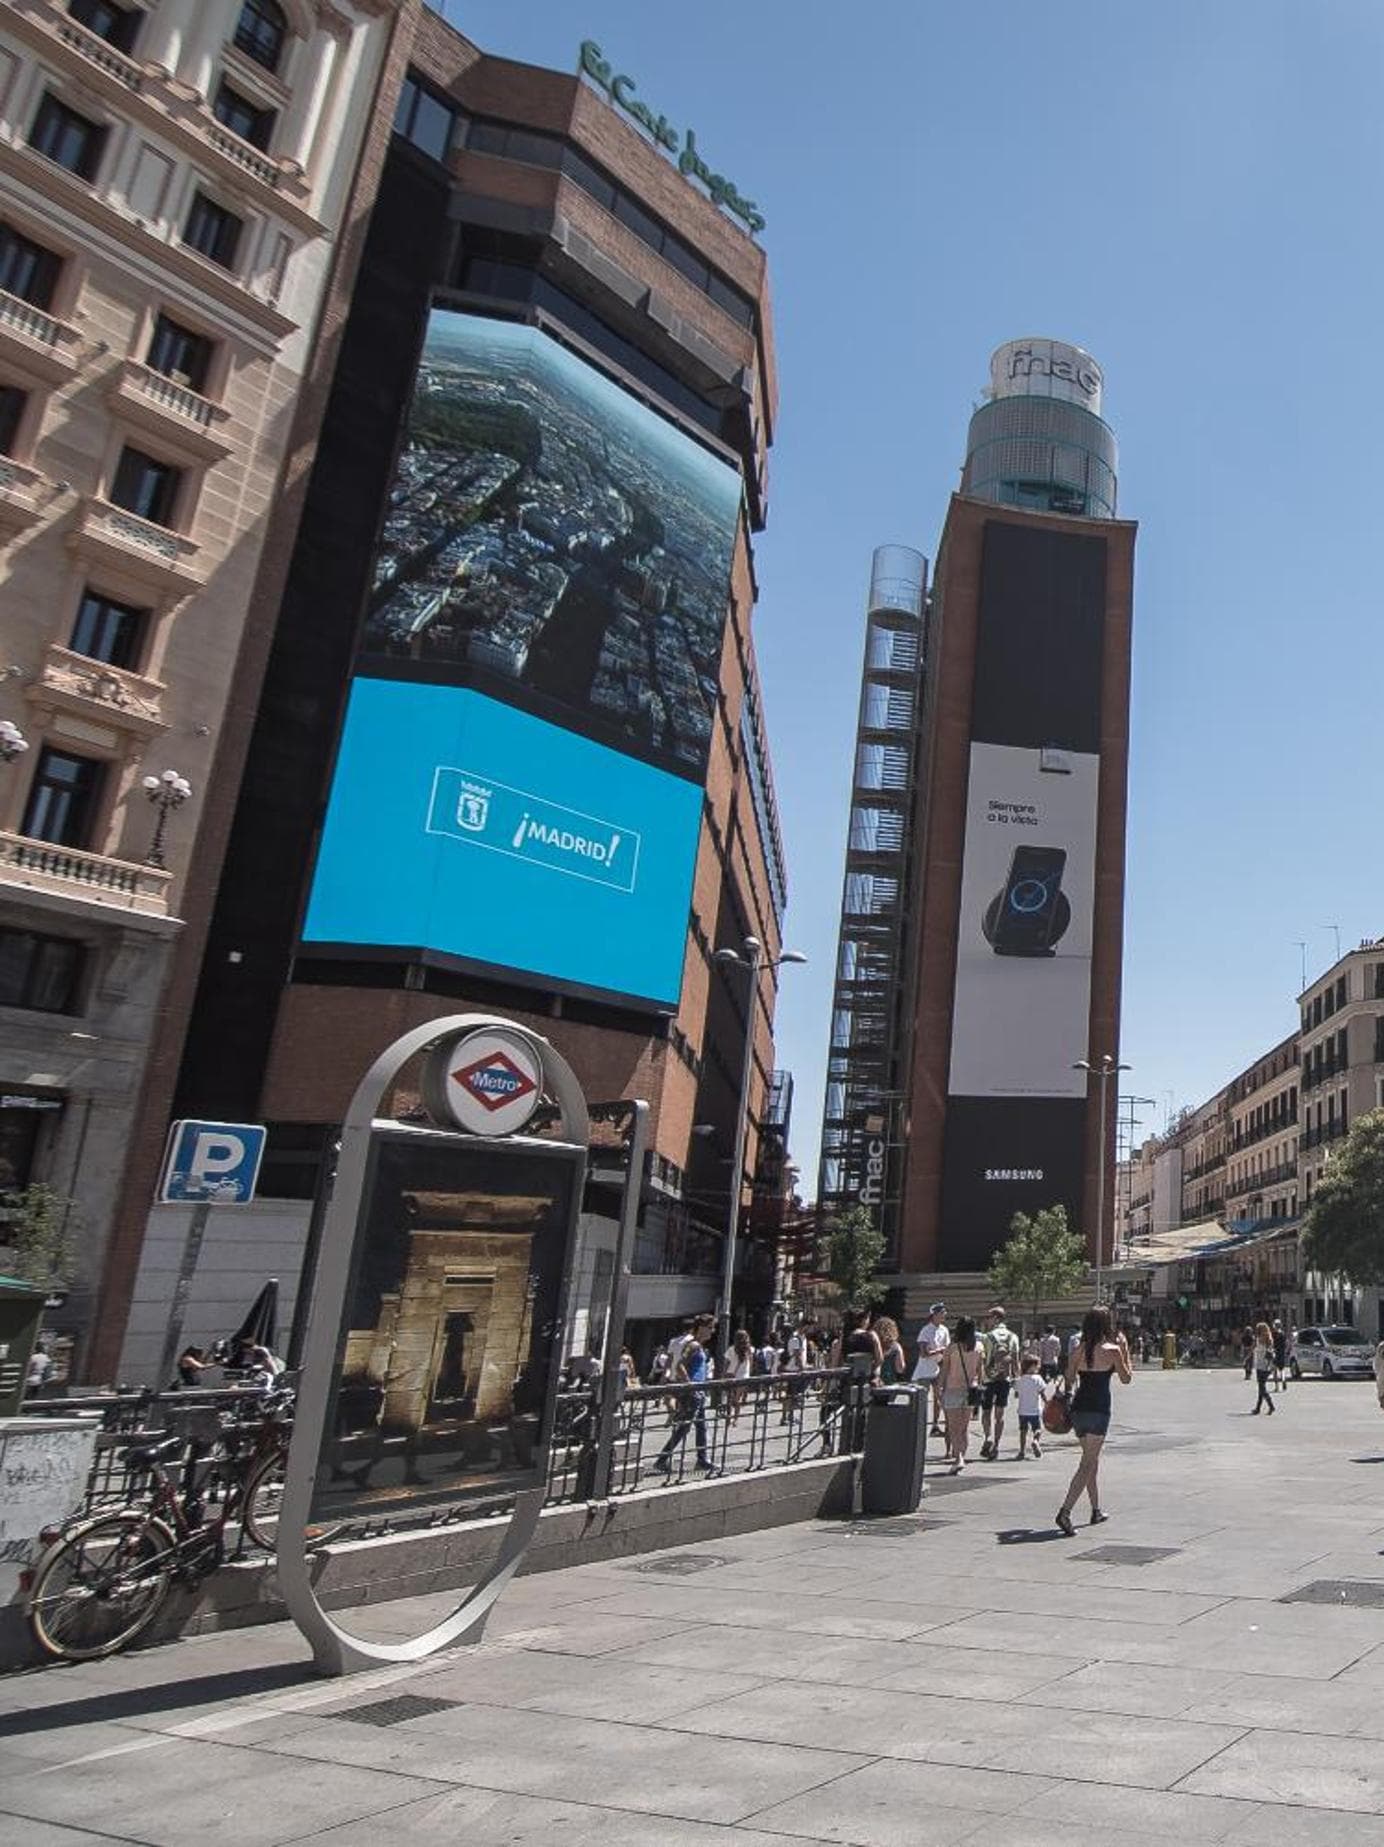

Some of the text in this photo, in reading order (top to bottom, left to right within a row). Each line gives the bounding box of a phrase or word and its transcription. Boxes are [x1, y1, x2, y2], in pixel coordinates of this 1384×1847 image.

[473, 1072, 516, 1092] Metro
[191, 1133, 245, 1187] P
[859, 1141, 884, 1204] fnac
[985, 1169, 1043, 1180] SAMSUNG
